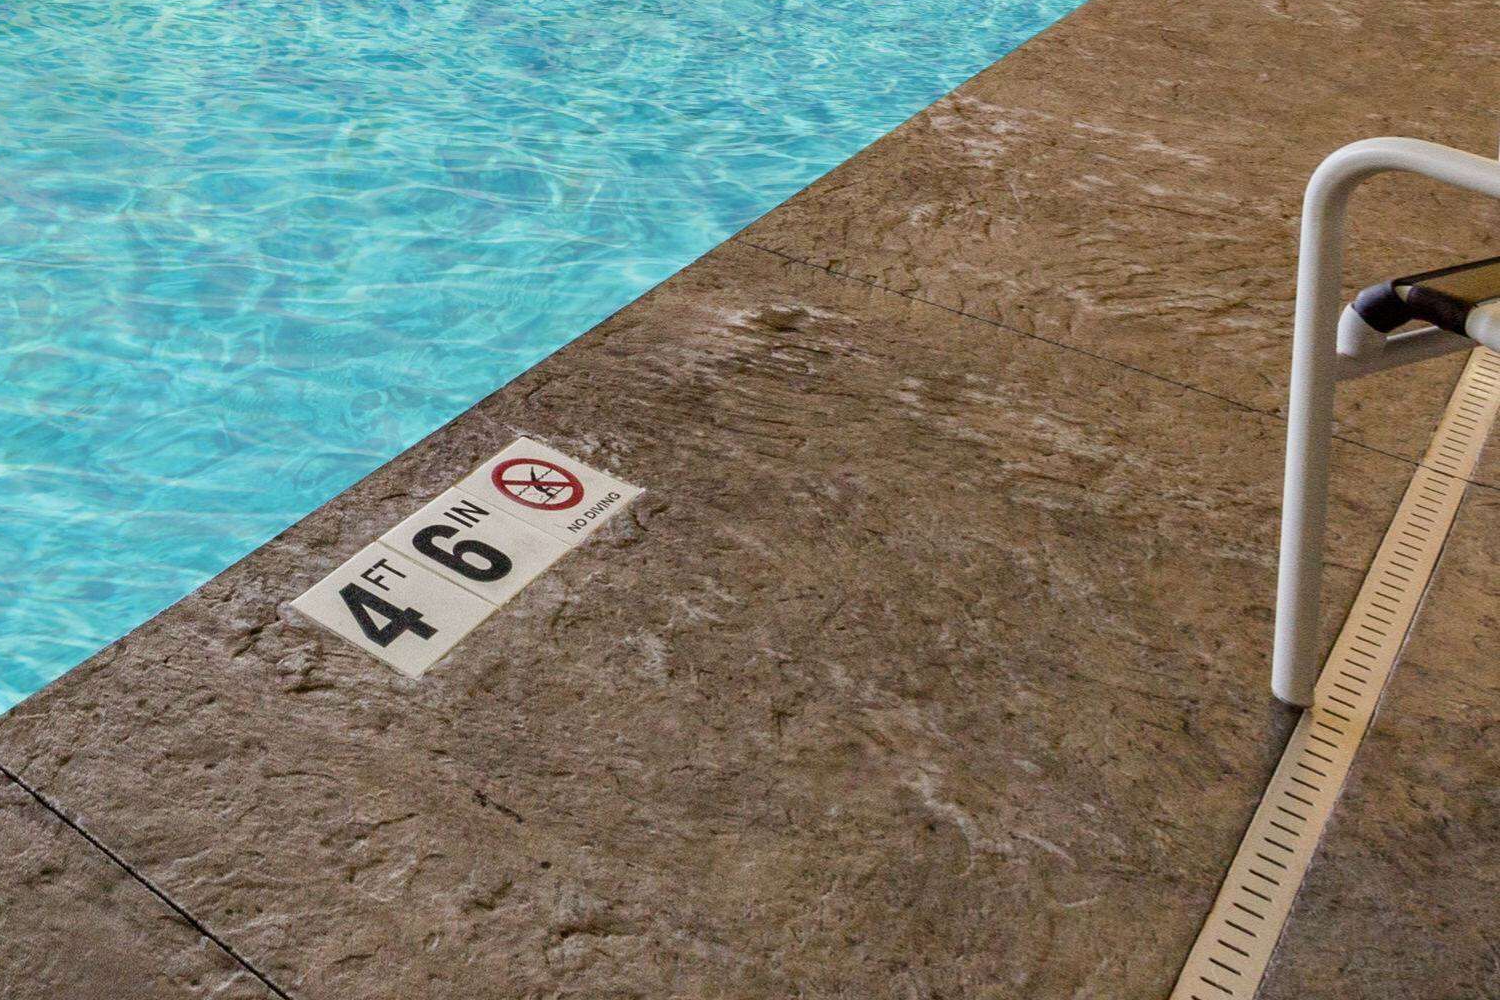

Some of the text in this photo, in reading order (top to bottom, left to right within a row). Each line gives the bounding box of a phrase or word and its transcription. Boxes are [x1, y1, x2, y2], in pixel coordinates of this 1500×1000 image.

[566, 490, 622, 535] NO DIVING
[338, 499, 513, 648] 4 FT 6 IN
